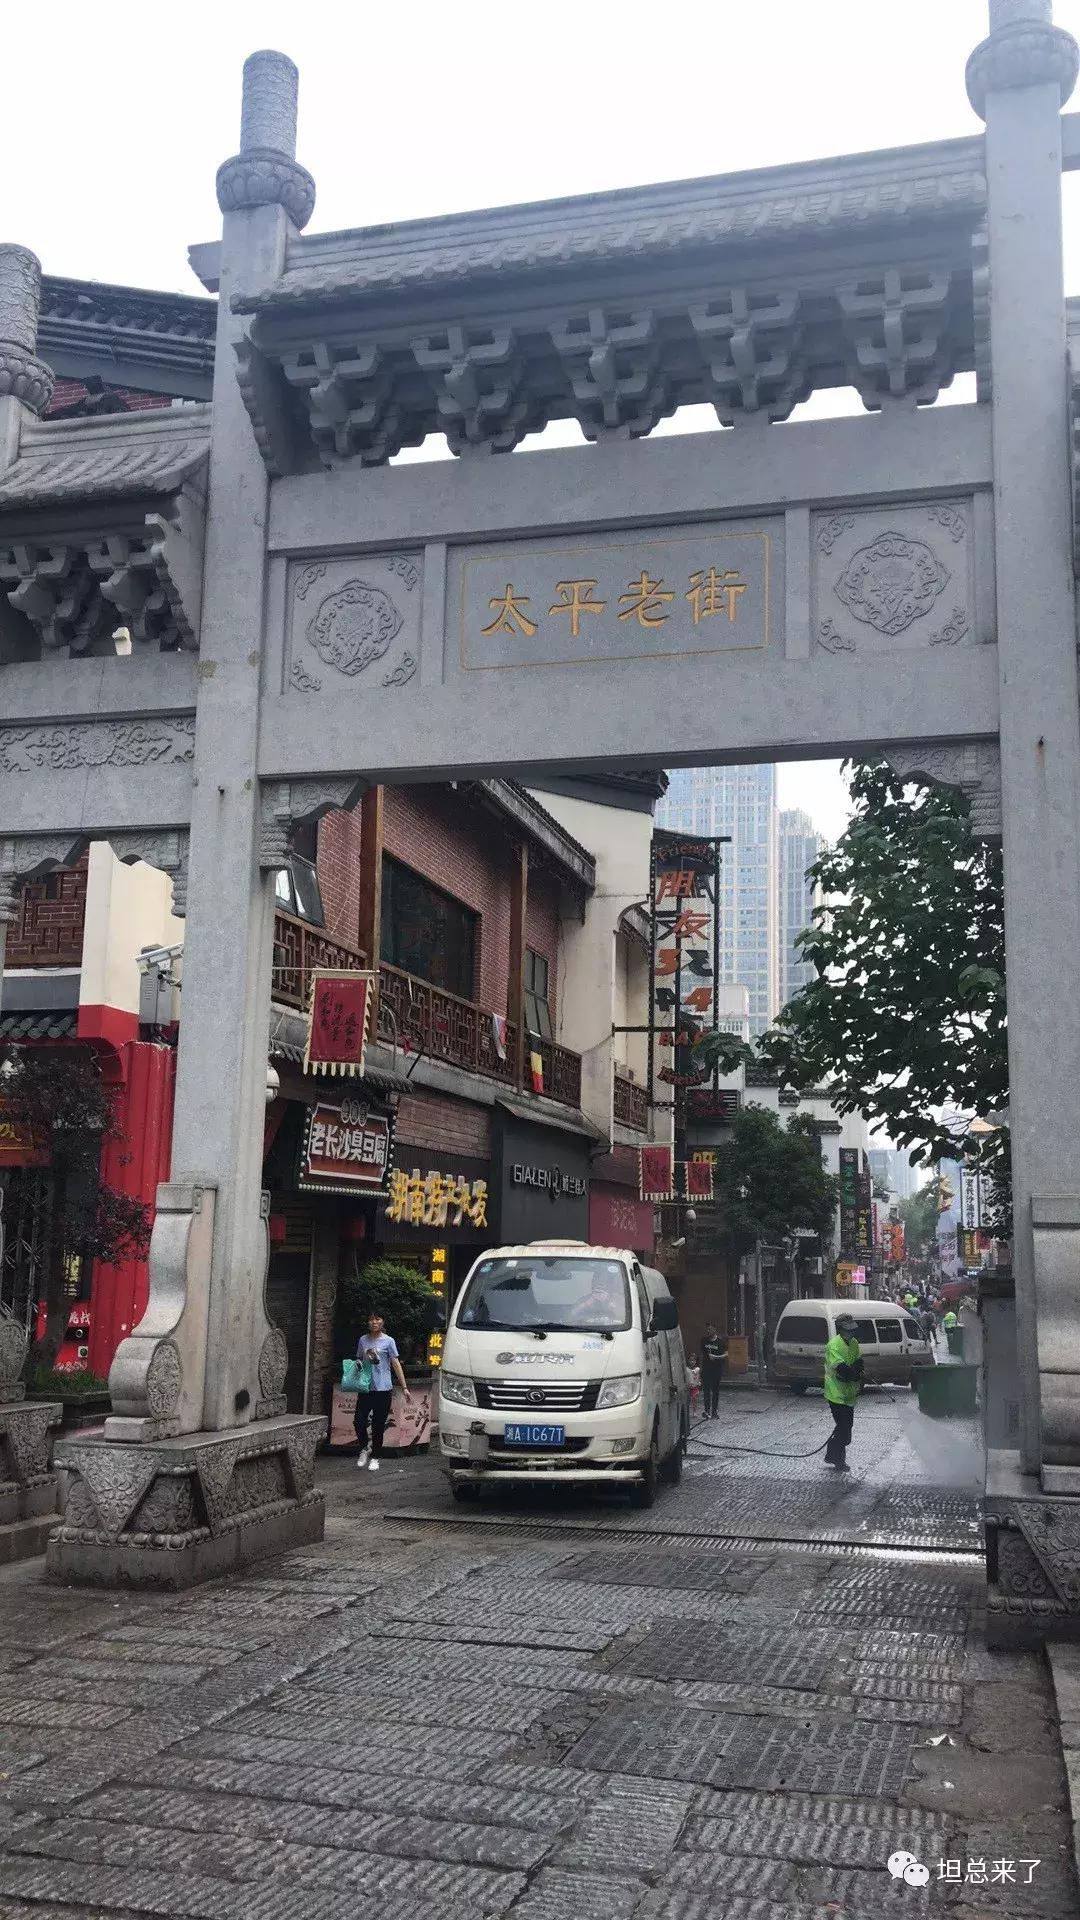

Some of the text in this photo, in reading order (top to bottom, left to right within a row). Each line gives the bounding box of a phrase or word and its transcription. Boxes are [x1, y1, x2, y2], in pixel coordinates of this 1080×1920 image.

[480, 567, 747, 637] 太平老街
[310, 1122, 386, 1167] 老长沙臭豆腐
[513, 1163, 552, 1189] GIALEN
